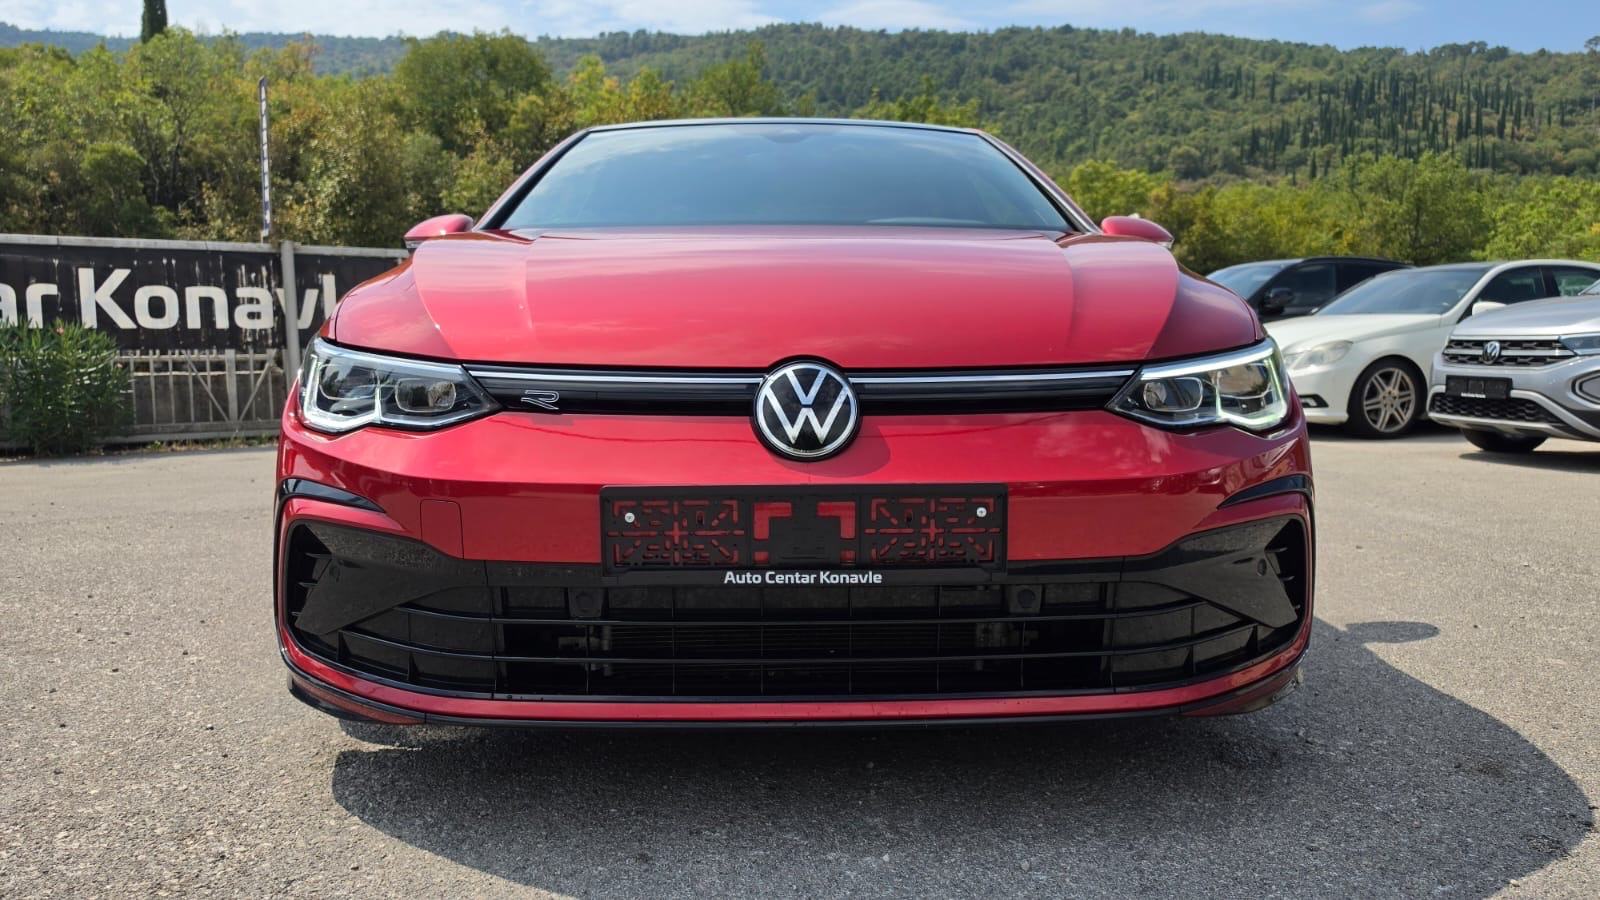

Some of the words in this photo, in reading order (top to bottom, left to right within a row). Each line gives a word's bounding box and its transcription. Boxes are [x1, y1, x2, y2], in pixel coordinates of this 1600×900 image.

[521, 389, 560, 410] R
[761, 366, 851, 446] VW
[724, 571, 762, 584] Auto
[765, 571, 817, 584] Centar
[819, 571, 883, 584] Konavle
